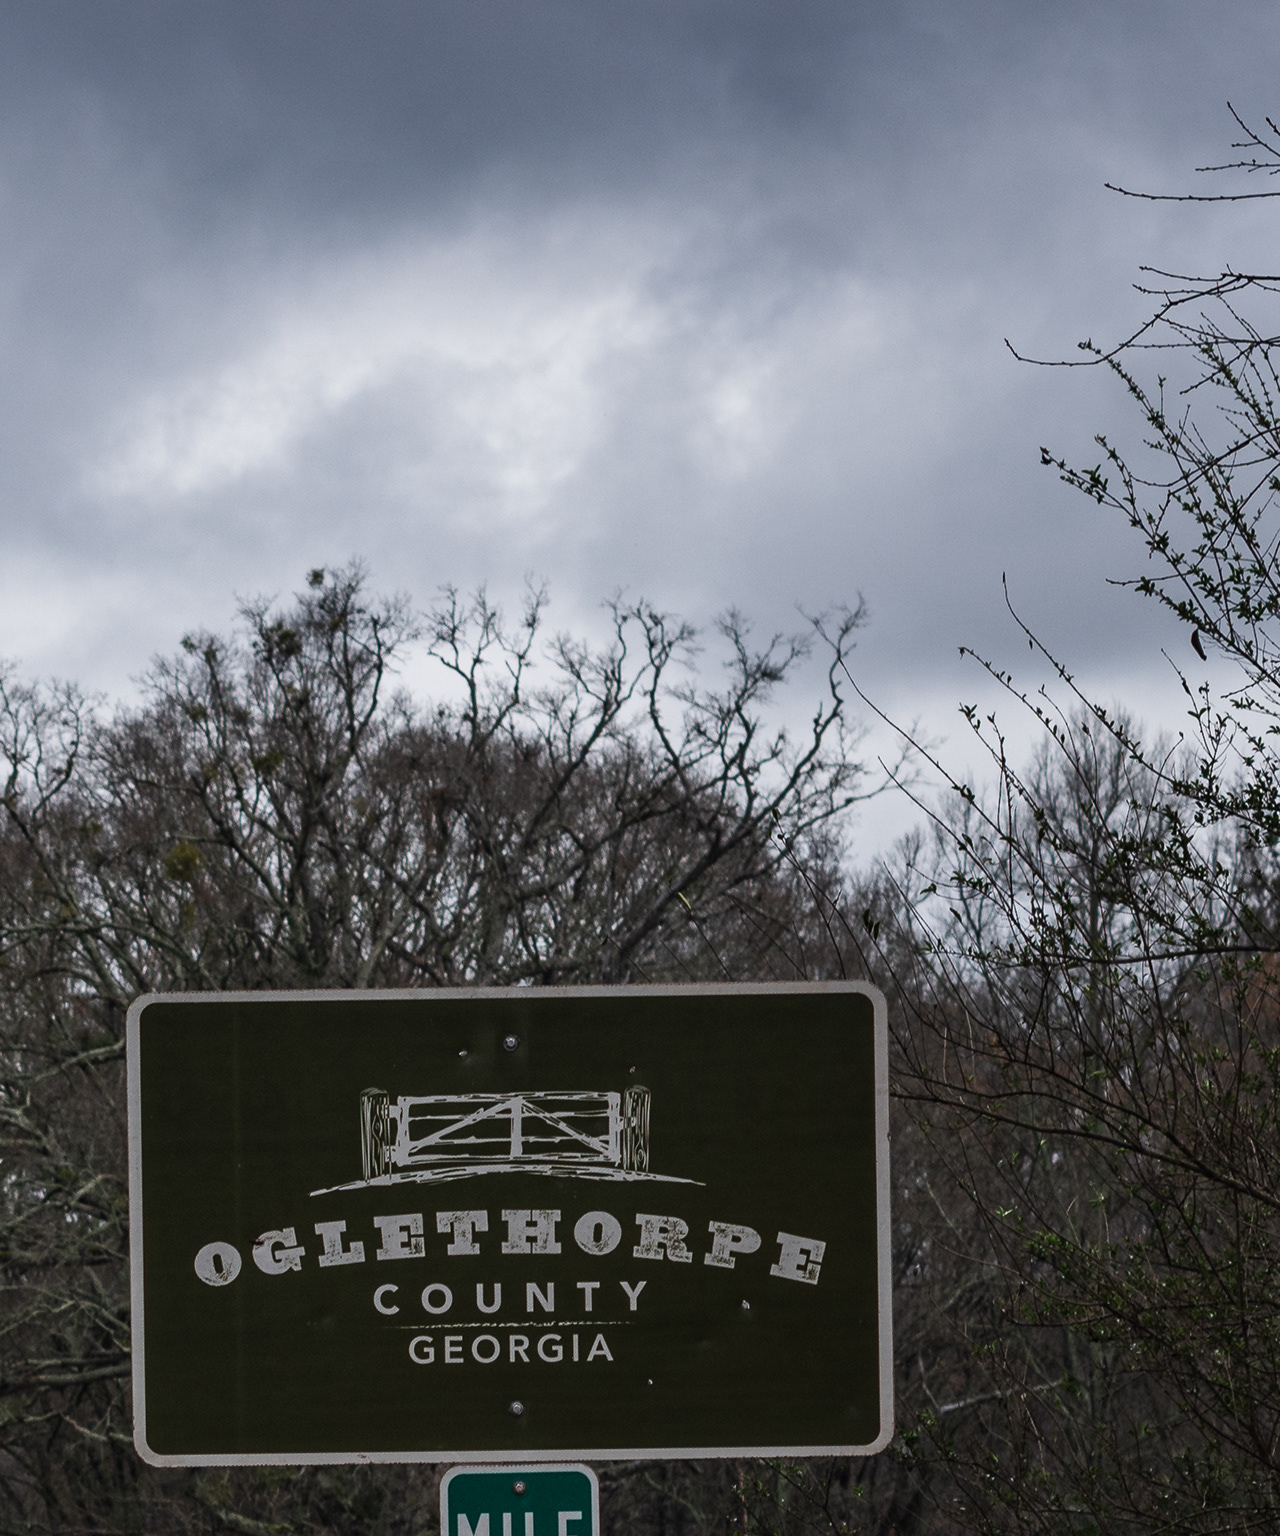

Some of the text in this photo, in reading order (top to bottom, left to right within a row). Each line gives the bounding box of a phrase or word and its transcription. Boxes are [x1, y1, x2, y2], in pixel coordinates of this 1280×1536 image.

[194, 1209, 826, 1286] OGLETHORPE
[373, 1280, 648, 1315] COUNTY
[408, 1334, 614, 1364] GEORGIA
